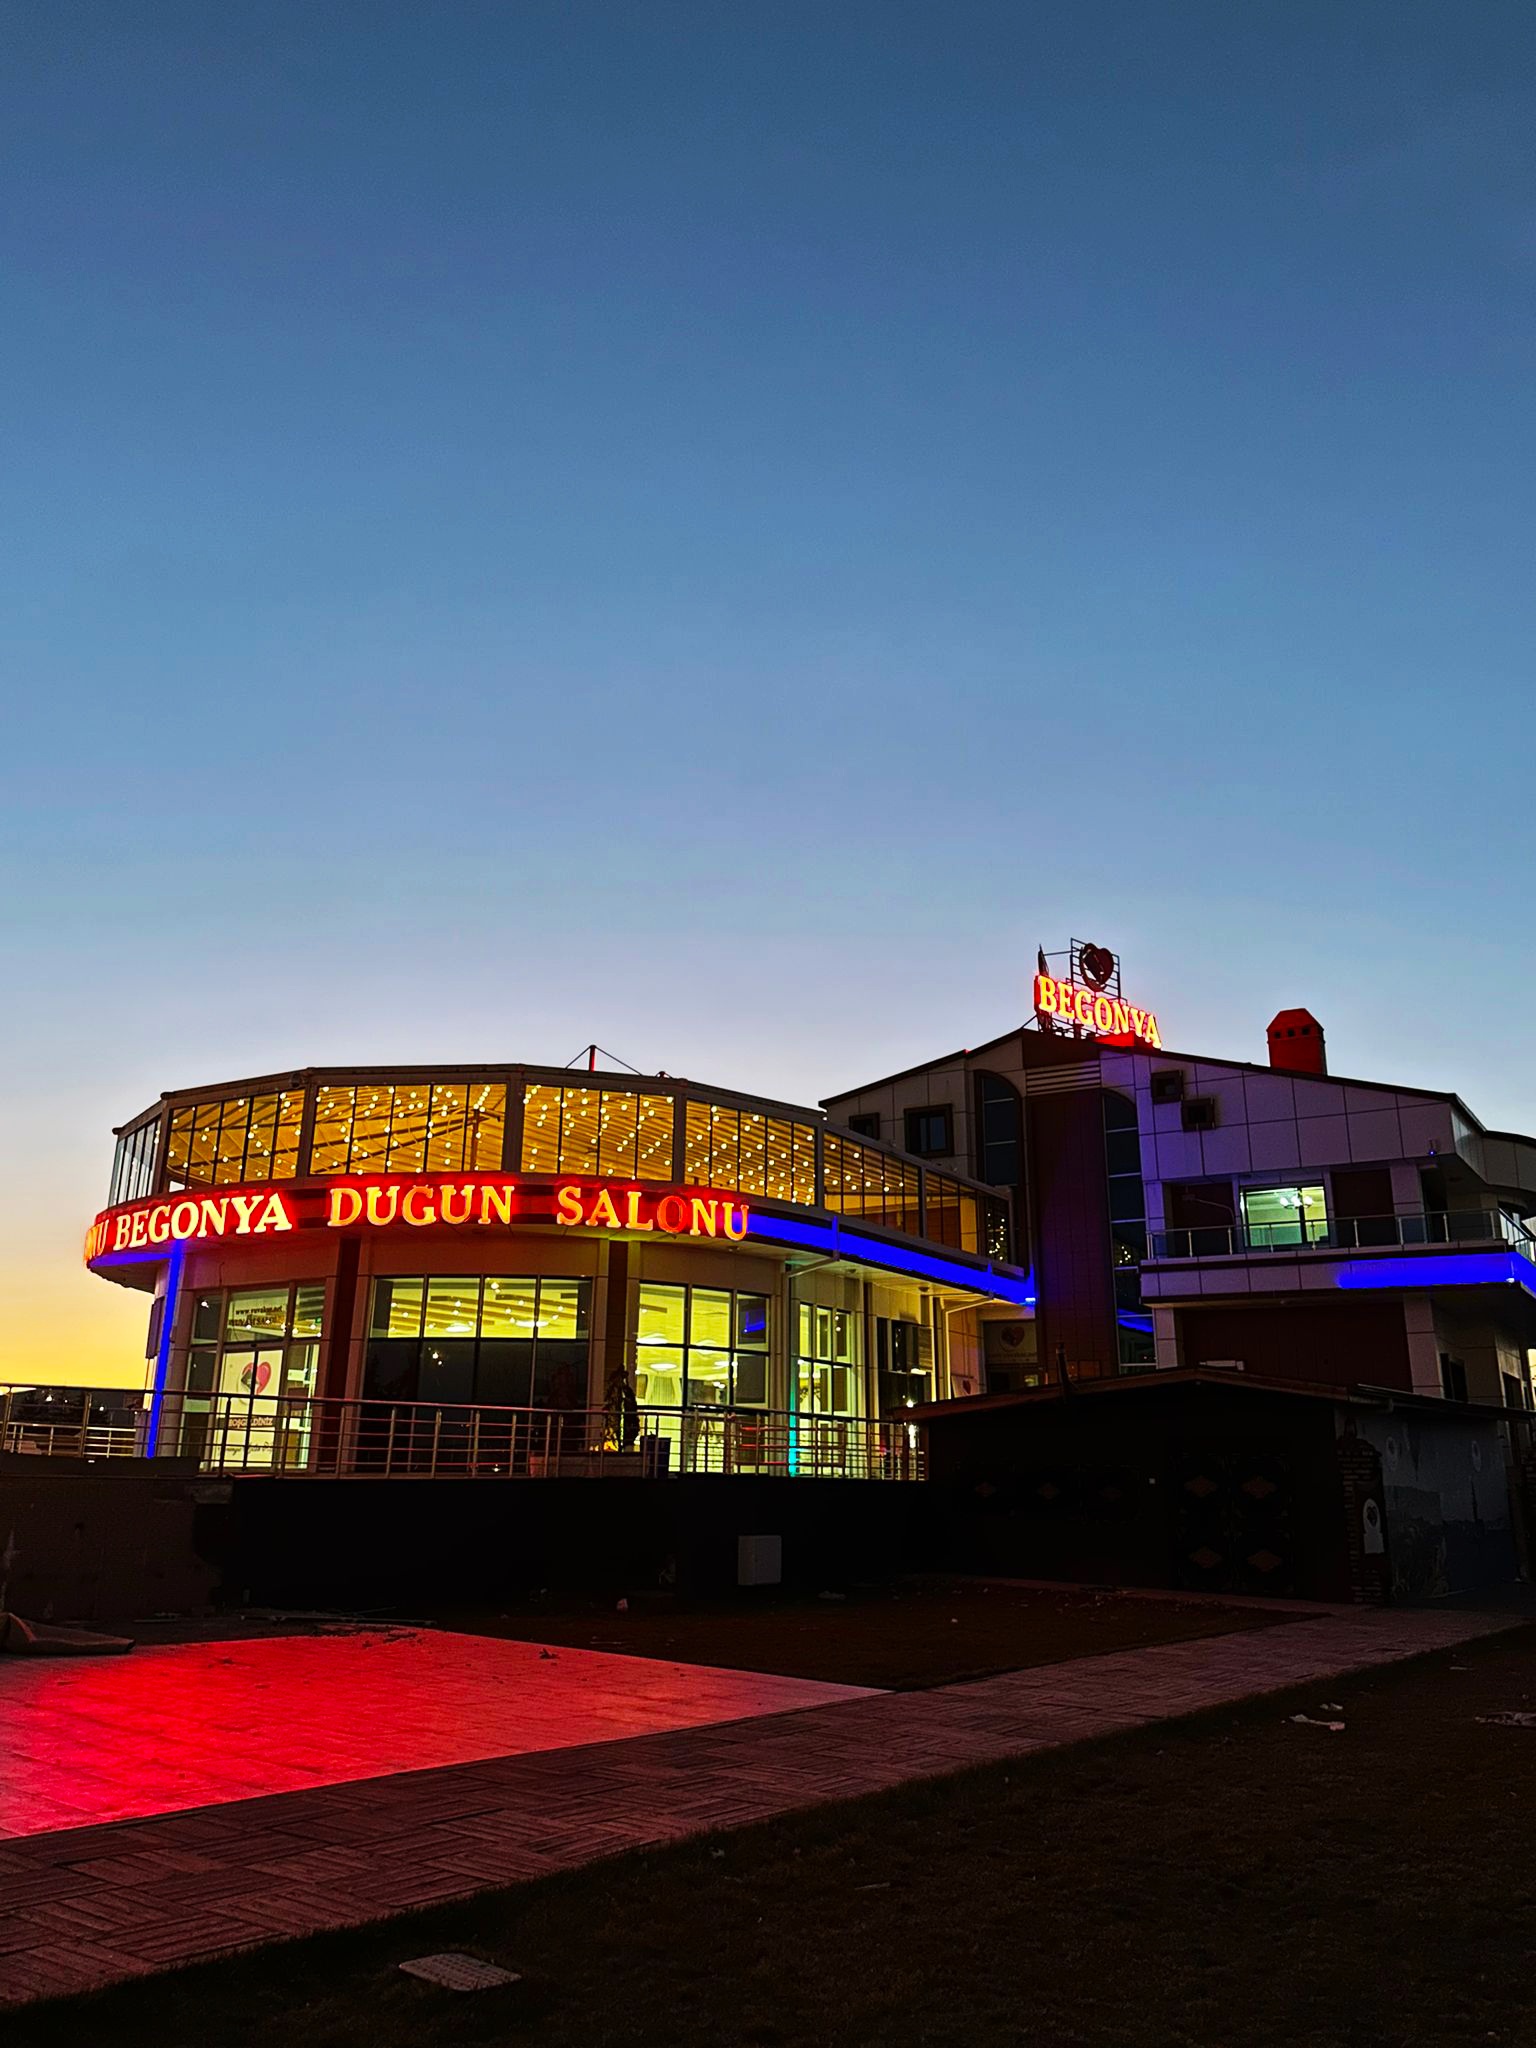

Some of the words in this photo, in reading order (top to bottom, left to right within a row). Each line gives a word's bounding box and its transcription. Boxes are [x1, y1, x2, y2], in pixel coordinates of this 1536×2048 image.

[1037, 974, 1163, 1050] BEGONYA
[113, 1192, 293, 1251] BEGONYA
[556, 1185, 750, 1241] SALONU
